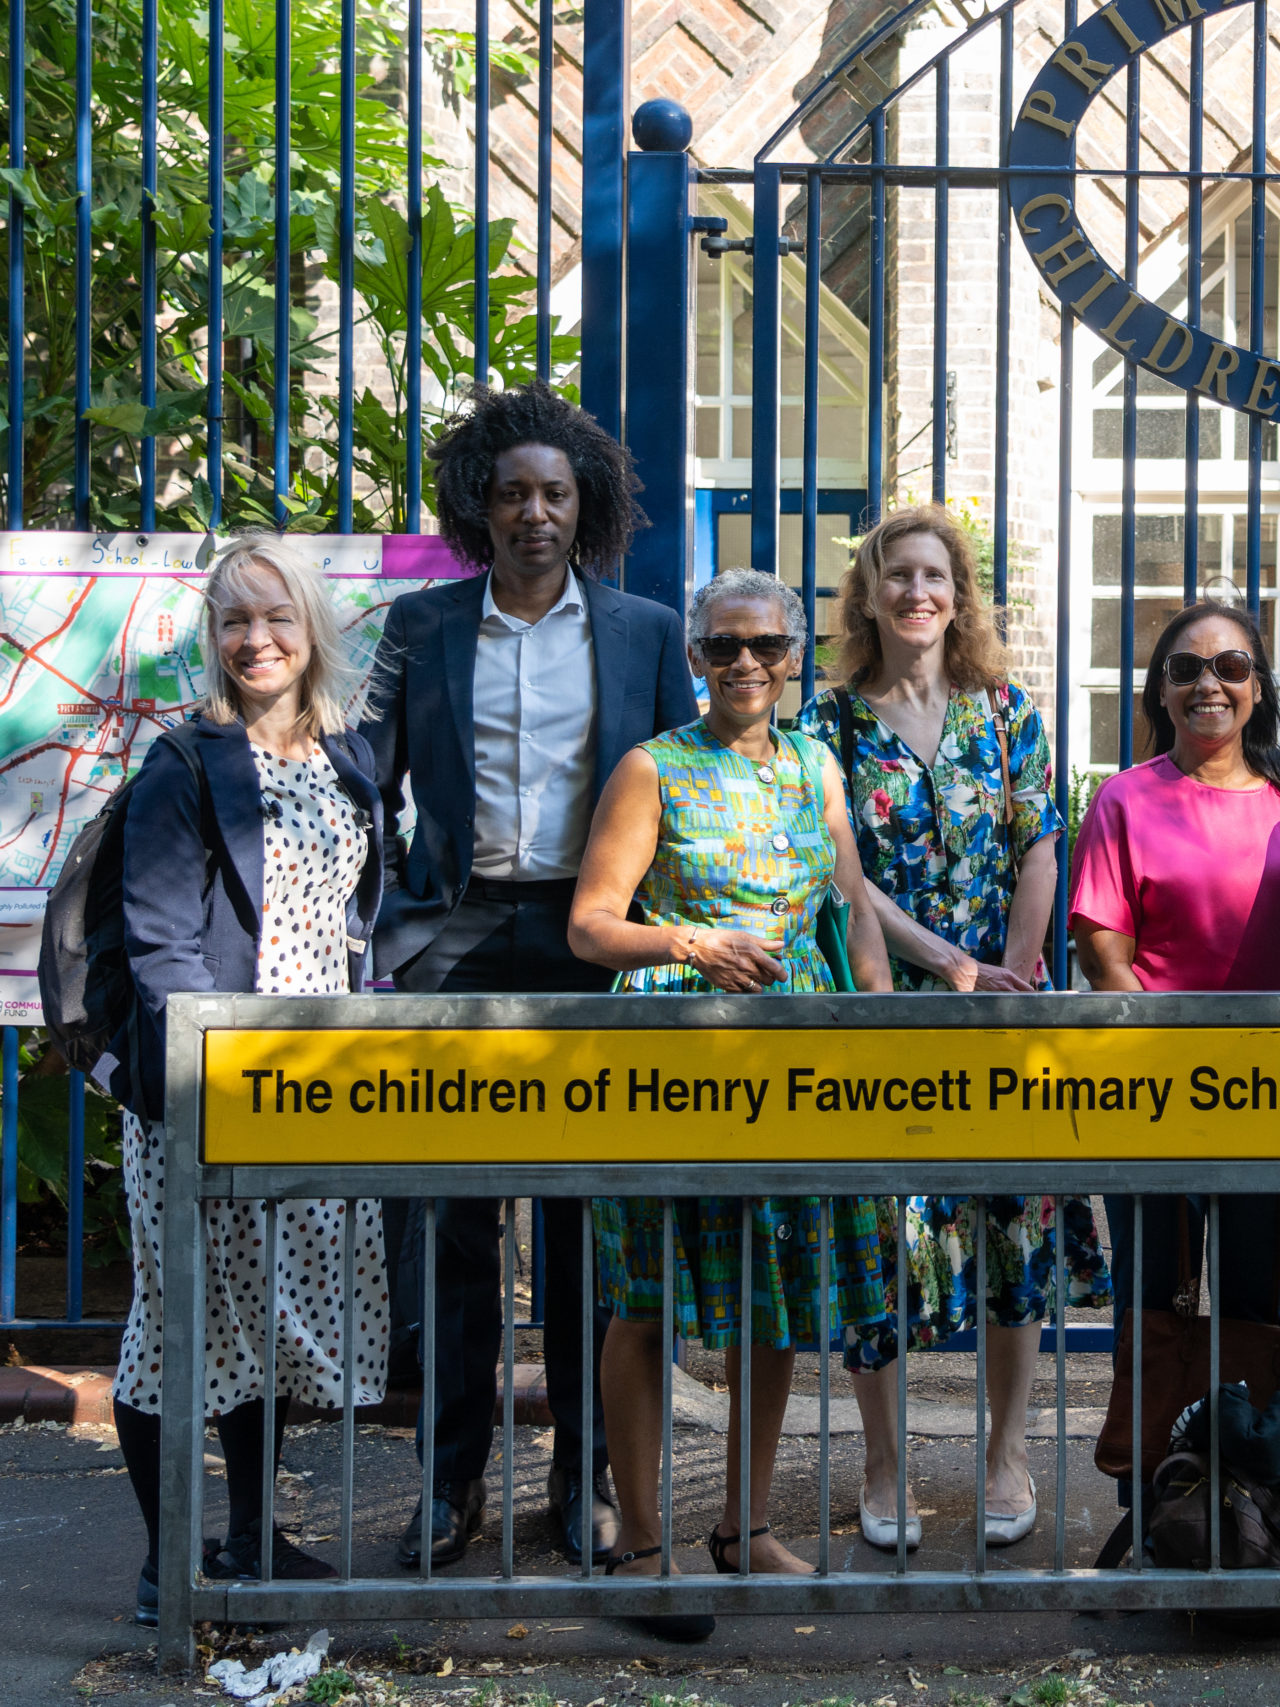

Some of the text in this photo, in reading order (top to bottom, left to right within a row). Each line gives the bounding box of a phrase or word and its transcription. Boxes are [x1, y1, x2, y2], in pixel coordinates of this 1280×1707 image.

[1021, 0, 1208, 139] PRIM
[92, 538, 147, 565] School
[4, 1001, 44, 1010] COMMU
[4, 1009, 28, 1017] FUND
[241, 1068, 334, 1114] The
[349, 1067, 547, 1114] children
[563, 1067, 611, 1114] of
[627, 1067, 770, 1125] Henry
[787, 1067, 972, 1113] Fawcett
[988, 1066, 1174, 1123] Primary
